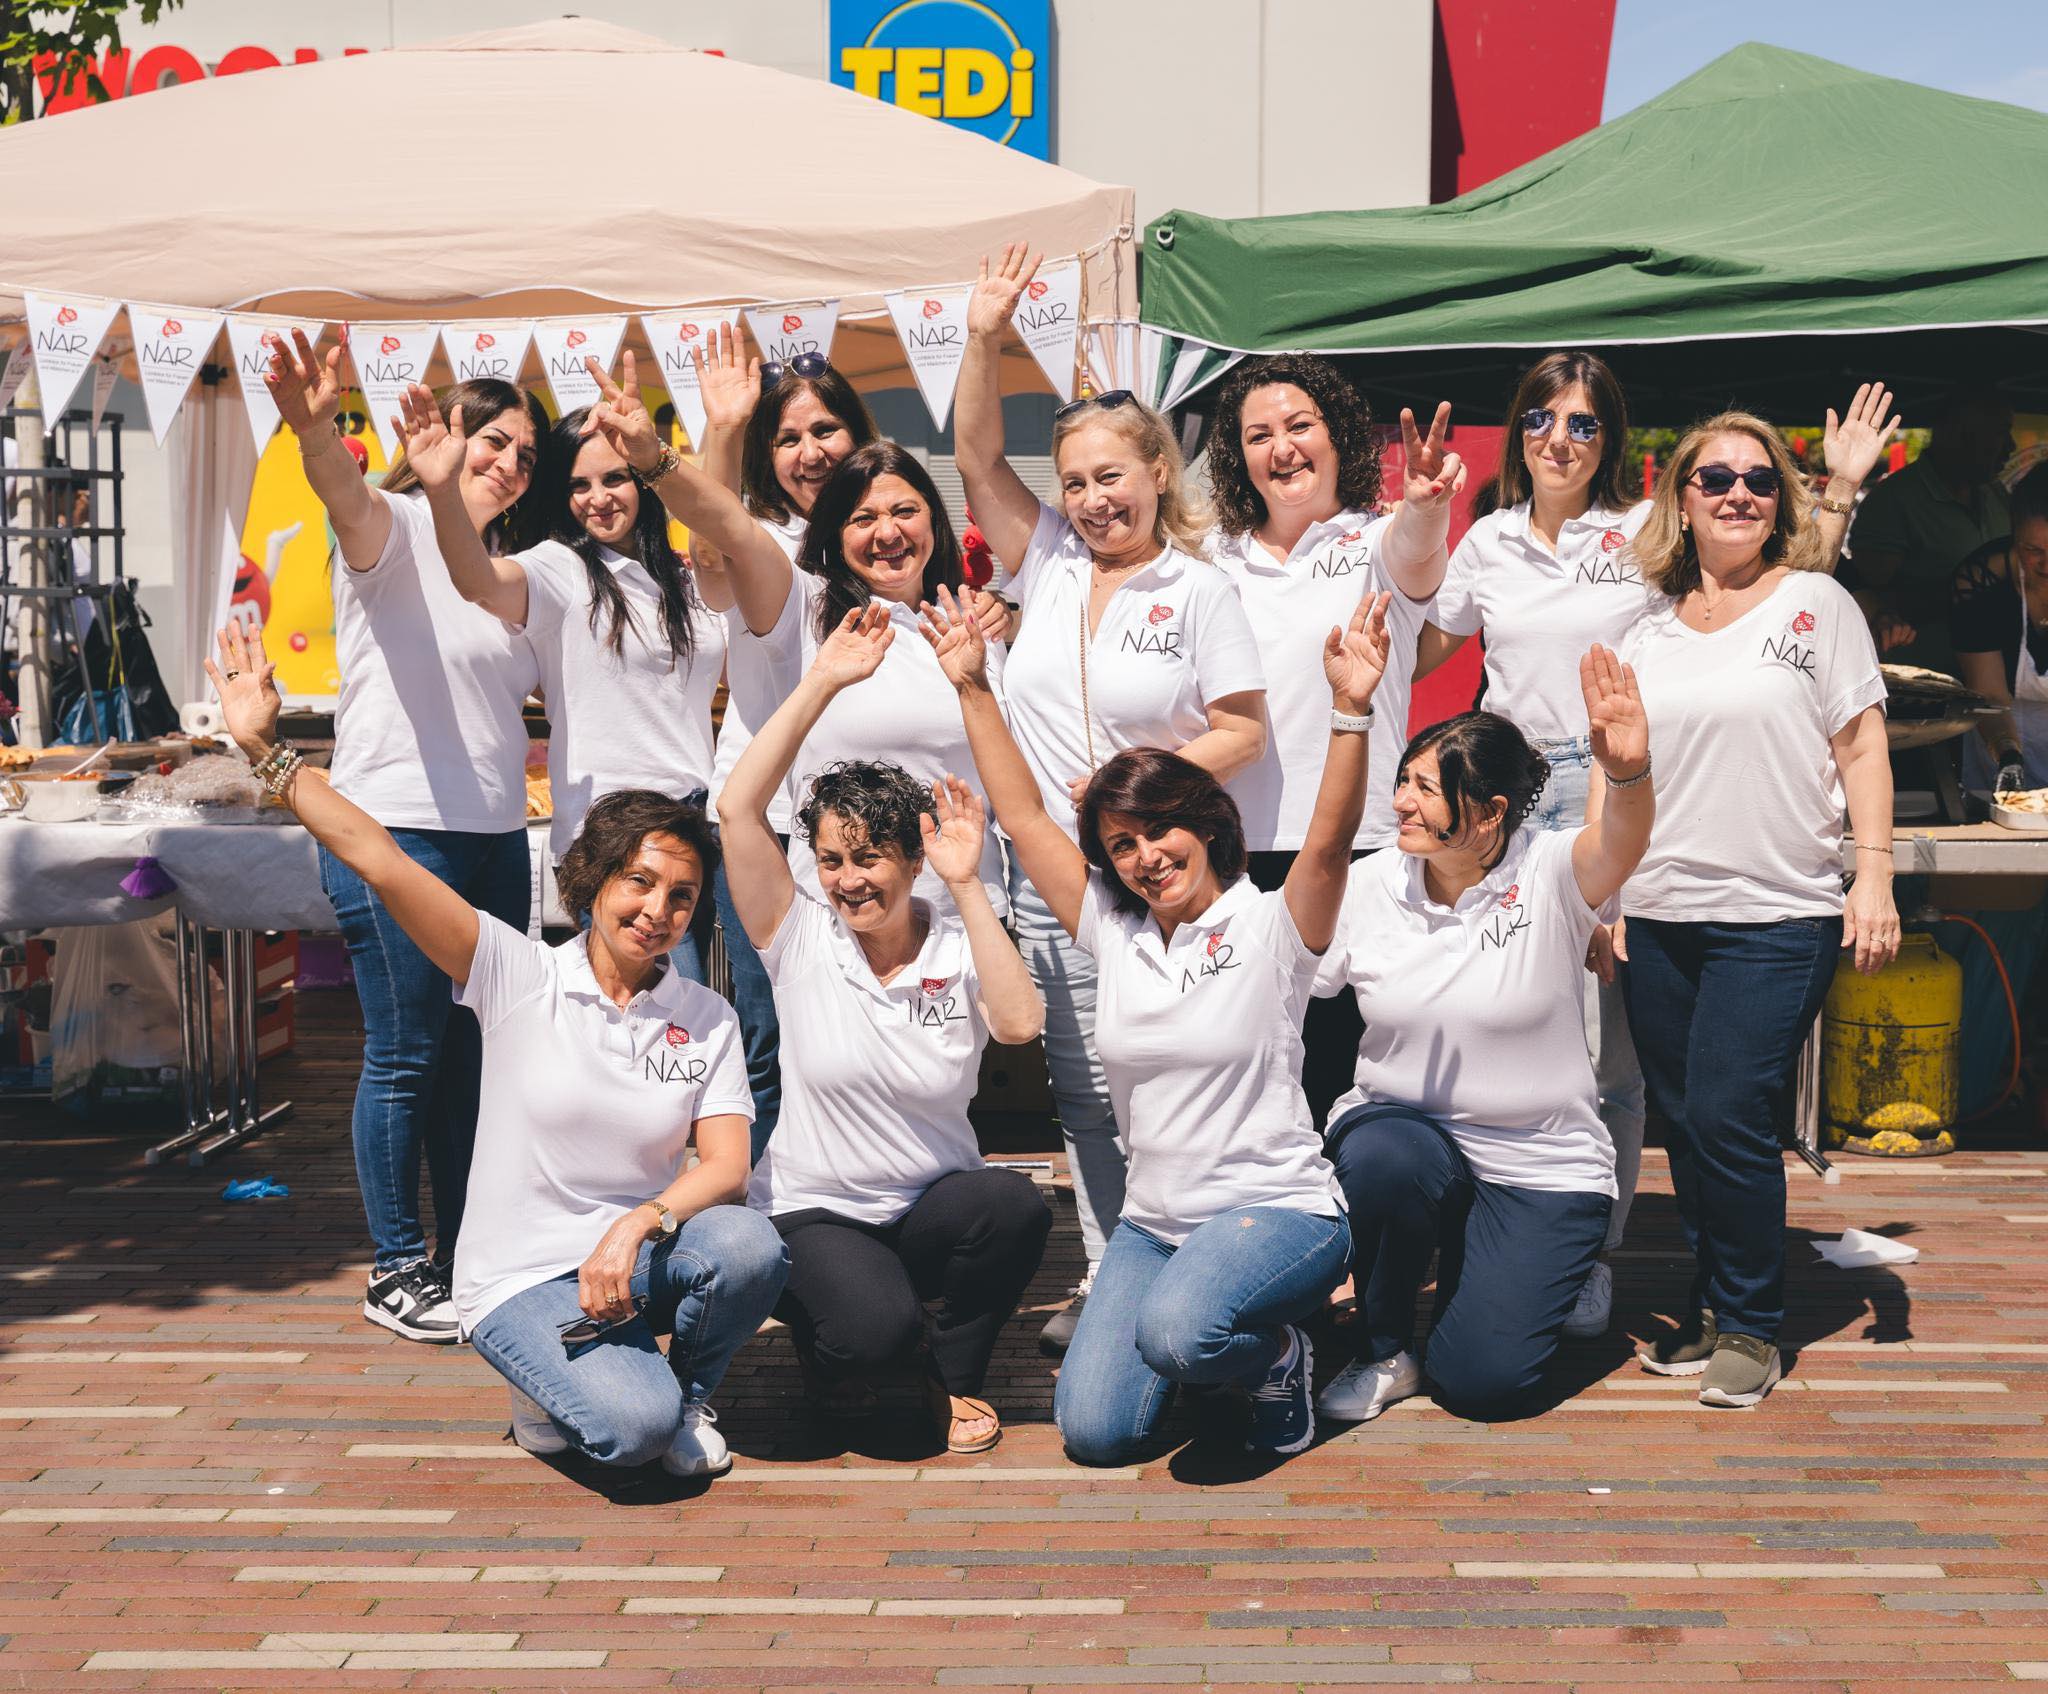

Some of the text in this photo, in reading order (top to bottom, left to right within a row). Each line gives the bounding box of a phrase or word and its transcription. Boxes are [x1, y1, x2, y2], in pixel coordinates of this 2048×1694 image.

[841, 47, 1034, 118] TEDi
[1019, 303, 1075, 333] NAR
[37, 327, 90, 356] NAR
[909, 322, 963, 348] NAR
[142, 339, 195, 369] NAR
[242, 350, 273, 374] NA
[460, 355, 513, 380] NAR
[666, 345, 709, 371] NA
[365, 358, 418, 382] NAR
[1575, 556, 1646, 585] NAR
[1121, 627, 1183, 660] NAR
[645, 1050, 707, 1085] NAR
